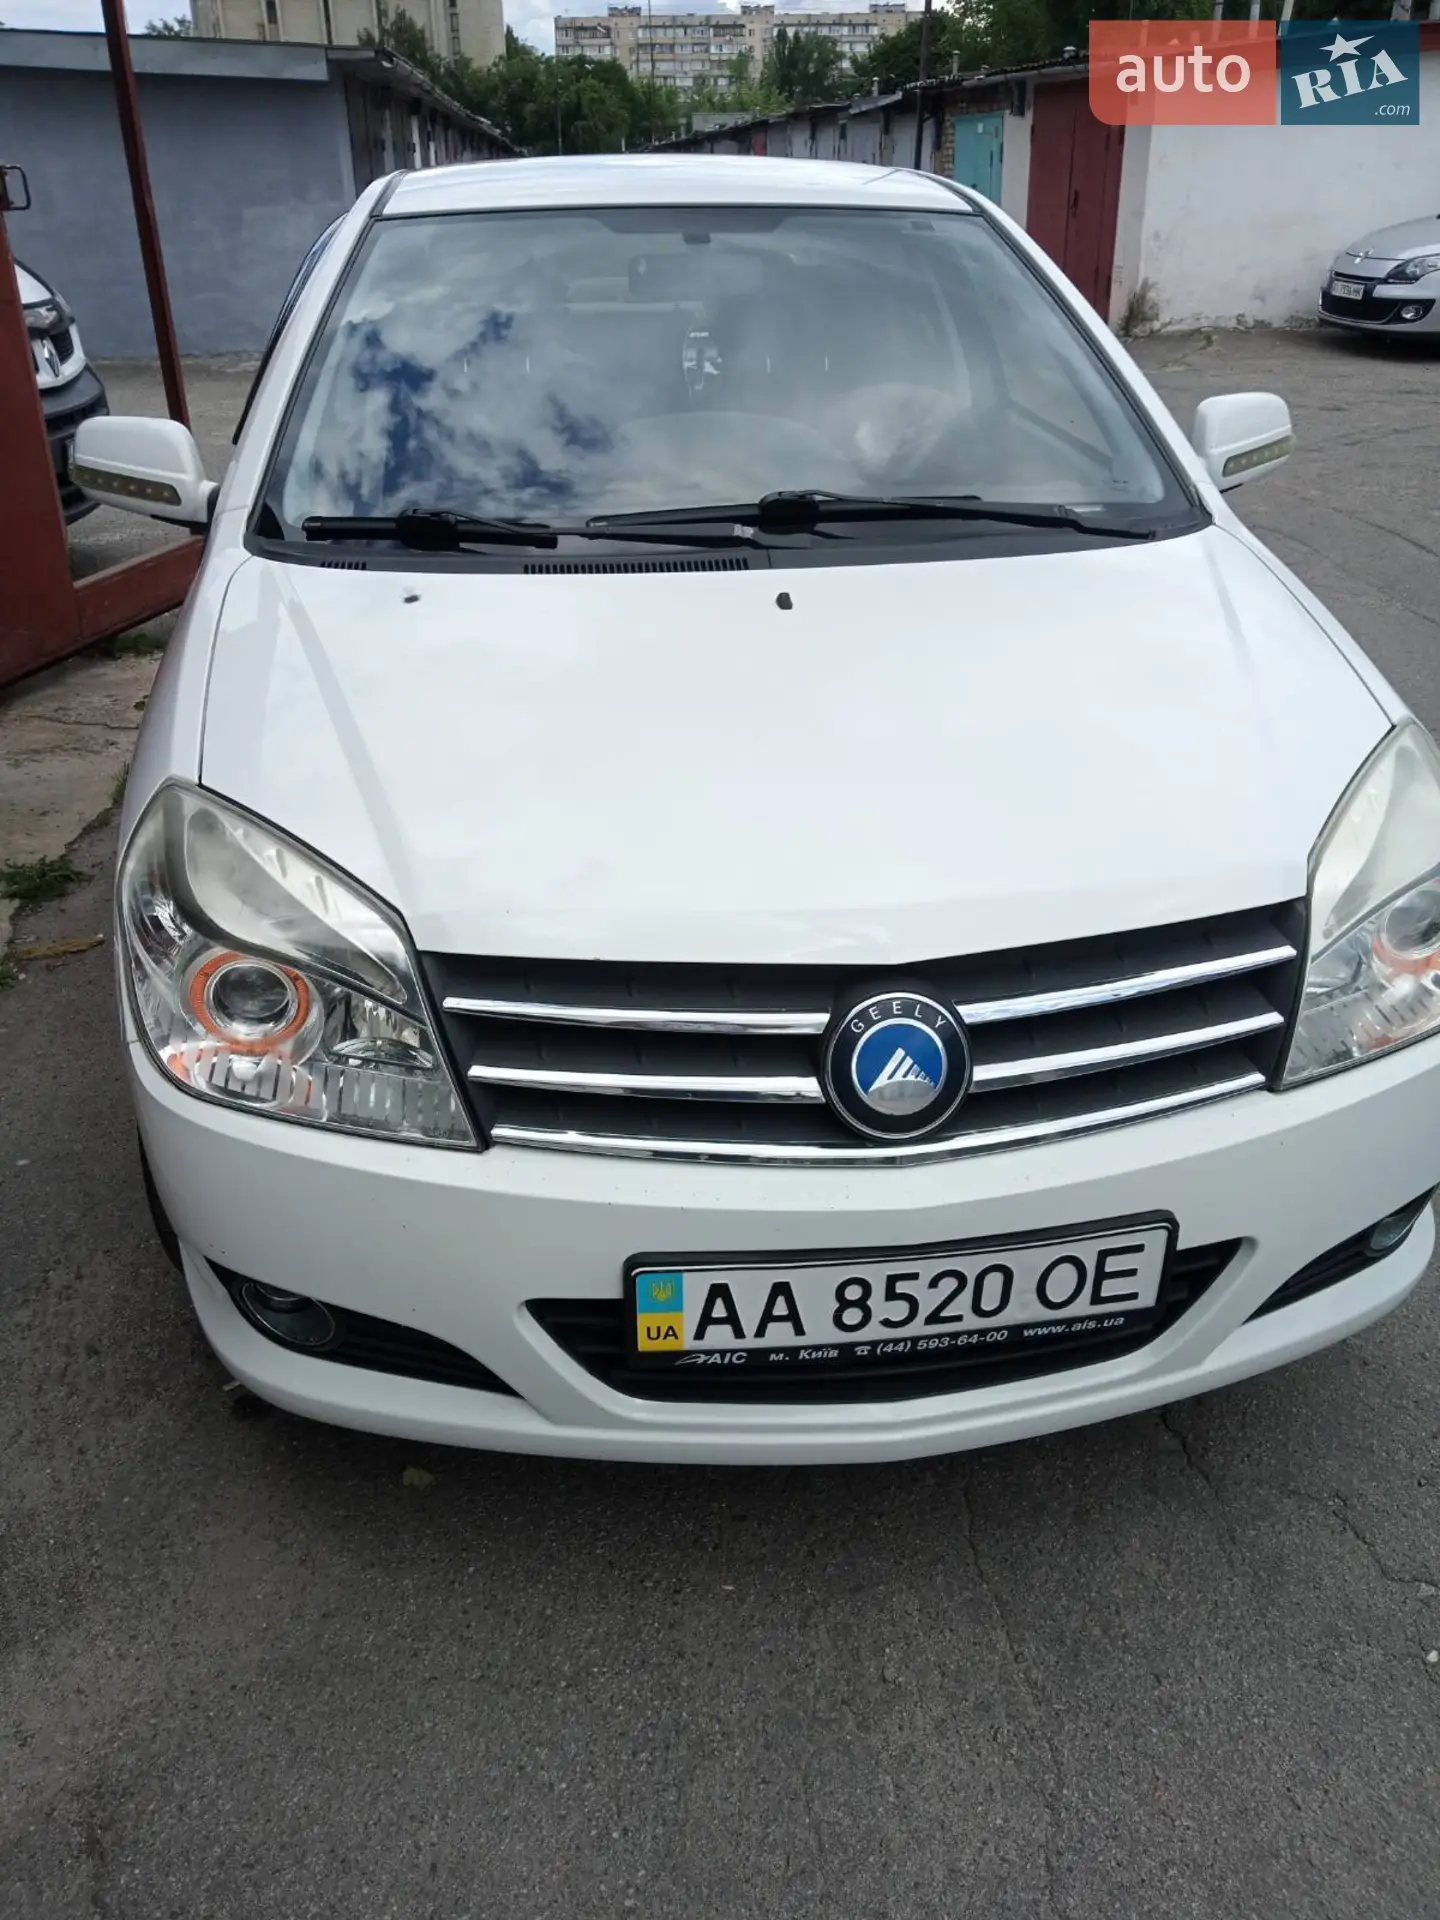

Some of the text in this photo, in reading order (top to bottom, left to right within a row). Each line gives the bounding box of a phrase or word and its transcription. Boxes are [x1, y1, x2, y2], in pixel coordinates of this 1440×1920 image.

[850, 1000, 947, 1034] GEELY
[693, 1243, 1146, 1341] AA 8520 OE
[646, 1325, 680, 1341] UA
[798, 1347, 840, 1360] Київ
[876, 1339, 912, 1356] (44)
[917, 1330, 1009, 1350] 593-64-00
[1022, 1315, 1125, 1338] www.ais.ua
